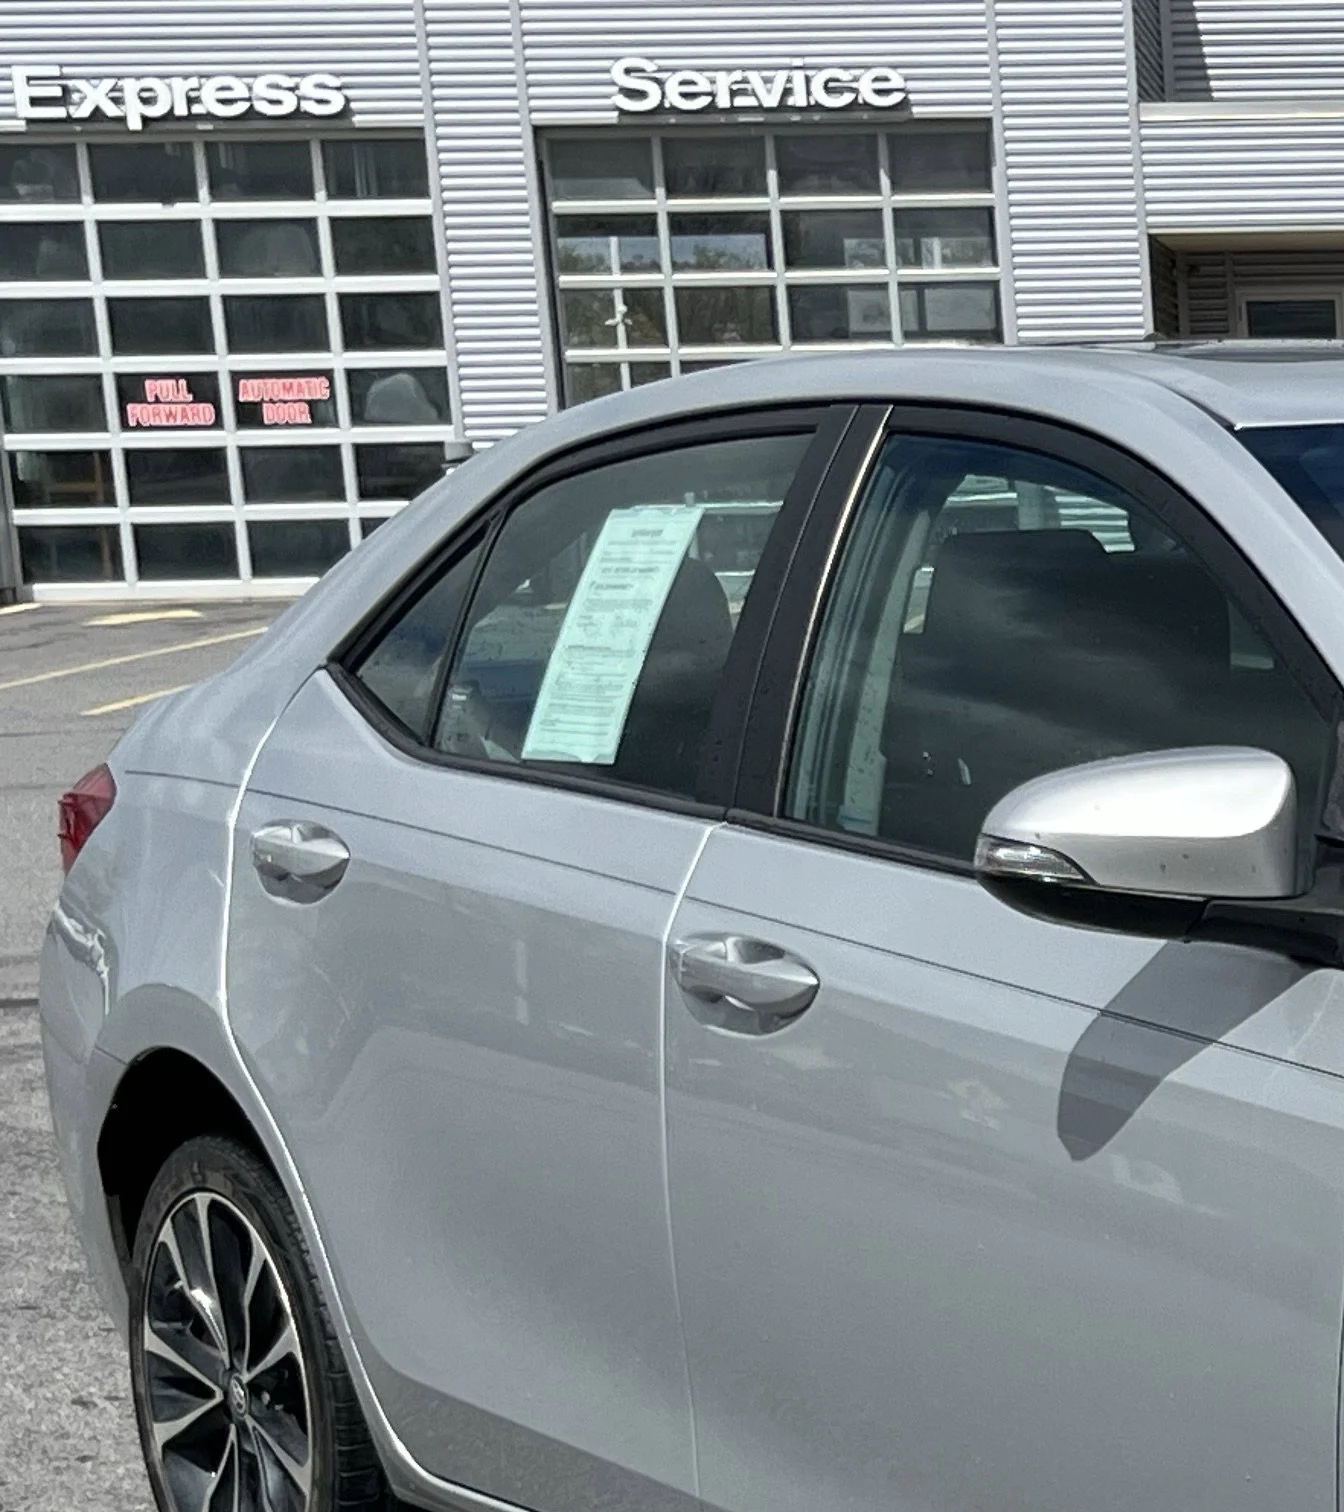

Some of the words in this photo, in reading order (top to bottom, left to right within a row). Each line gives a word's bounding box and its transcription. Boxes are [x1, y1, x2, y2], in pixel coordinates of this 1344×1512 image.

[610, 57, 906, 111] Service
[11, 64, 346, 131] Express
[145, 379, 193, 402] PULL
[239, 377, 330, 402] AUTOMATIC
[127, 403, 215, 426] FORWARD
[262, 403, 312, 424] DOOR
